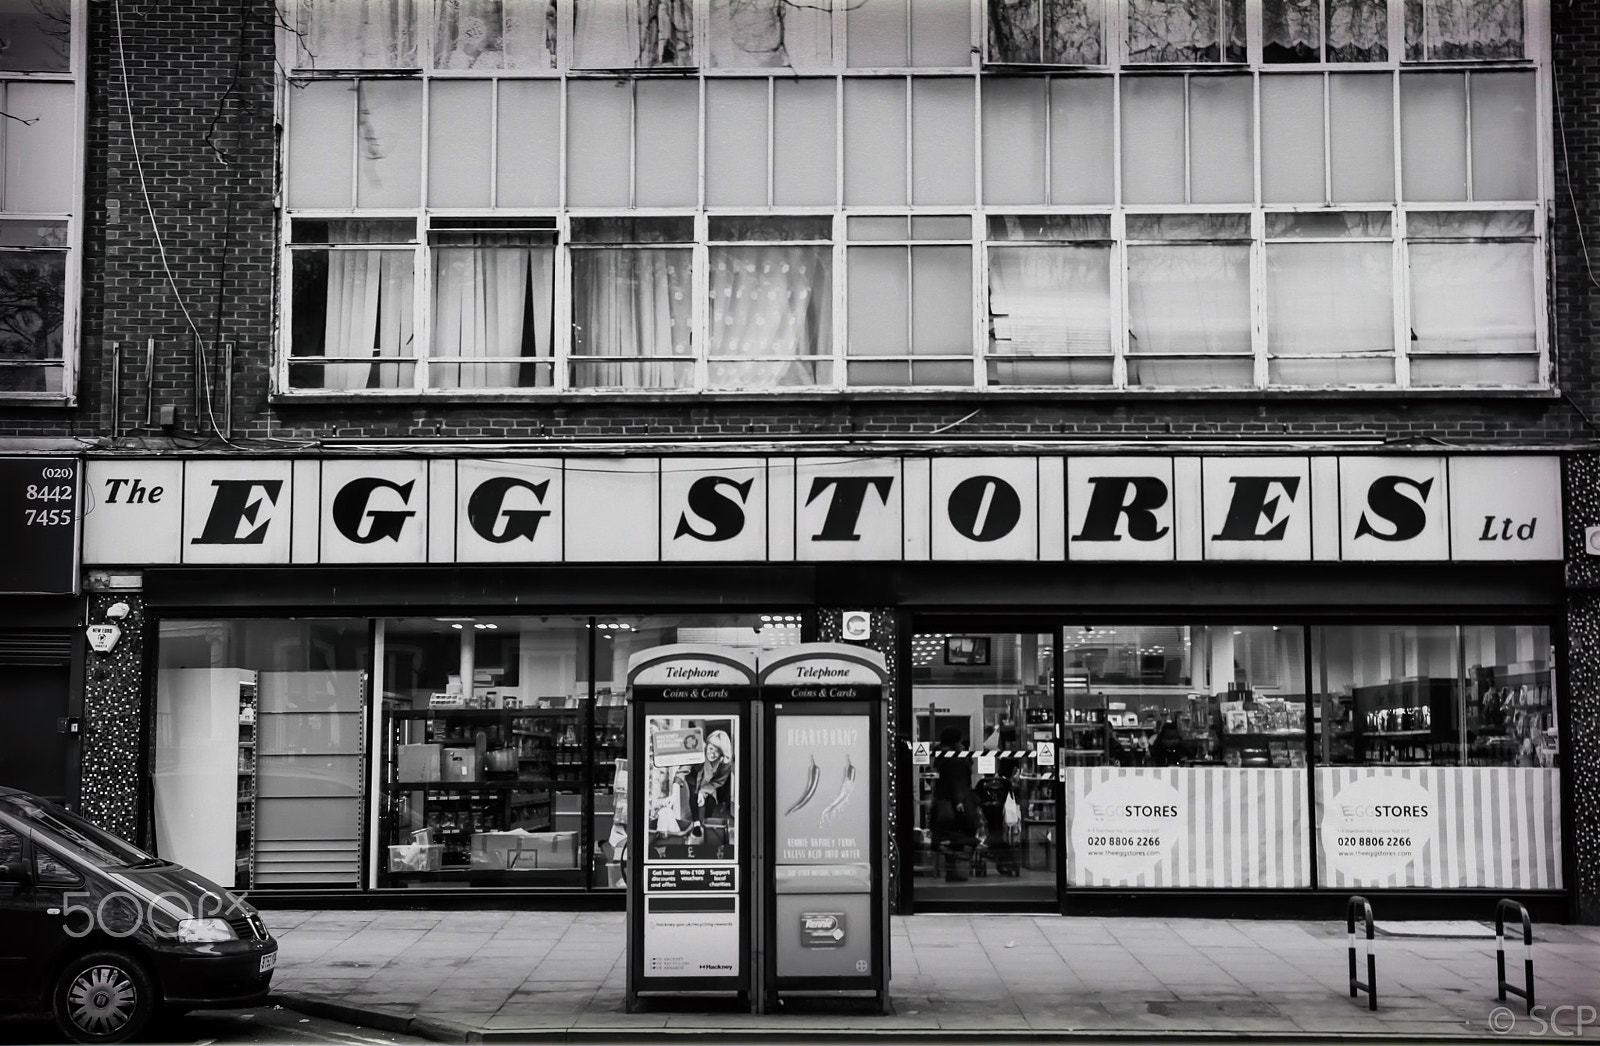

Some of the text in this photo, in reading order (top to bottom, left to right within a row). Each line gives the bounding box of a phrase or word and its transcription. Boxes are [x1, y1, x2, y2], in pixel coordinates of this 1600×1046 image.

[42, 467, 74, 480] (020)
[26, 484, 73, 502] 8442
[104, 475, 1538, 545] The EGG STORES Ltd
[25, 509, 71, 526] 7455
[665, 666, 720, 679] Telephone
[796, 666, 850, 679] Telephone
[662, 688, 729, 699] Coins & Cards
[791, 688, 857, 698] Coins & Cards
[787, 728, 858, 746] HEARTBURN?
[837, 838, 857, 848] TURNS
[1087, 836, 1161, 846] 020 8806 2266
[1337, 836, 1412, 847] 020 8806 2266
[783, 849, 861, 859] EXCESS ACID INTO WATER
[710, 869, 731, 877] Support
